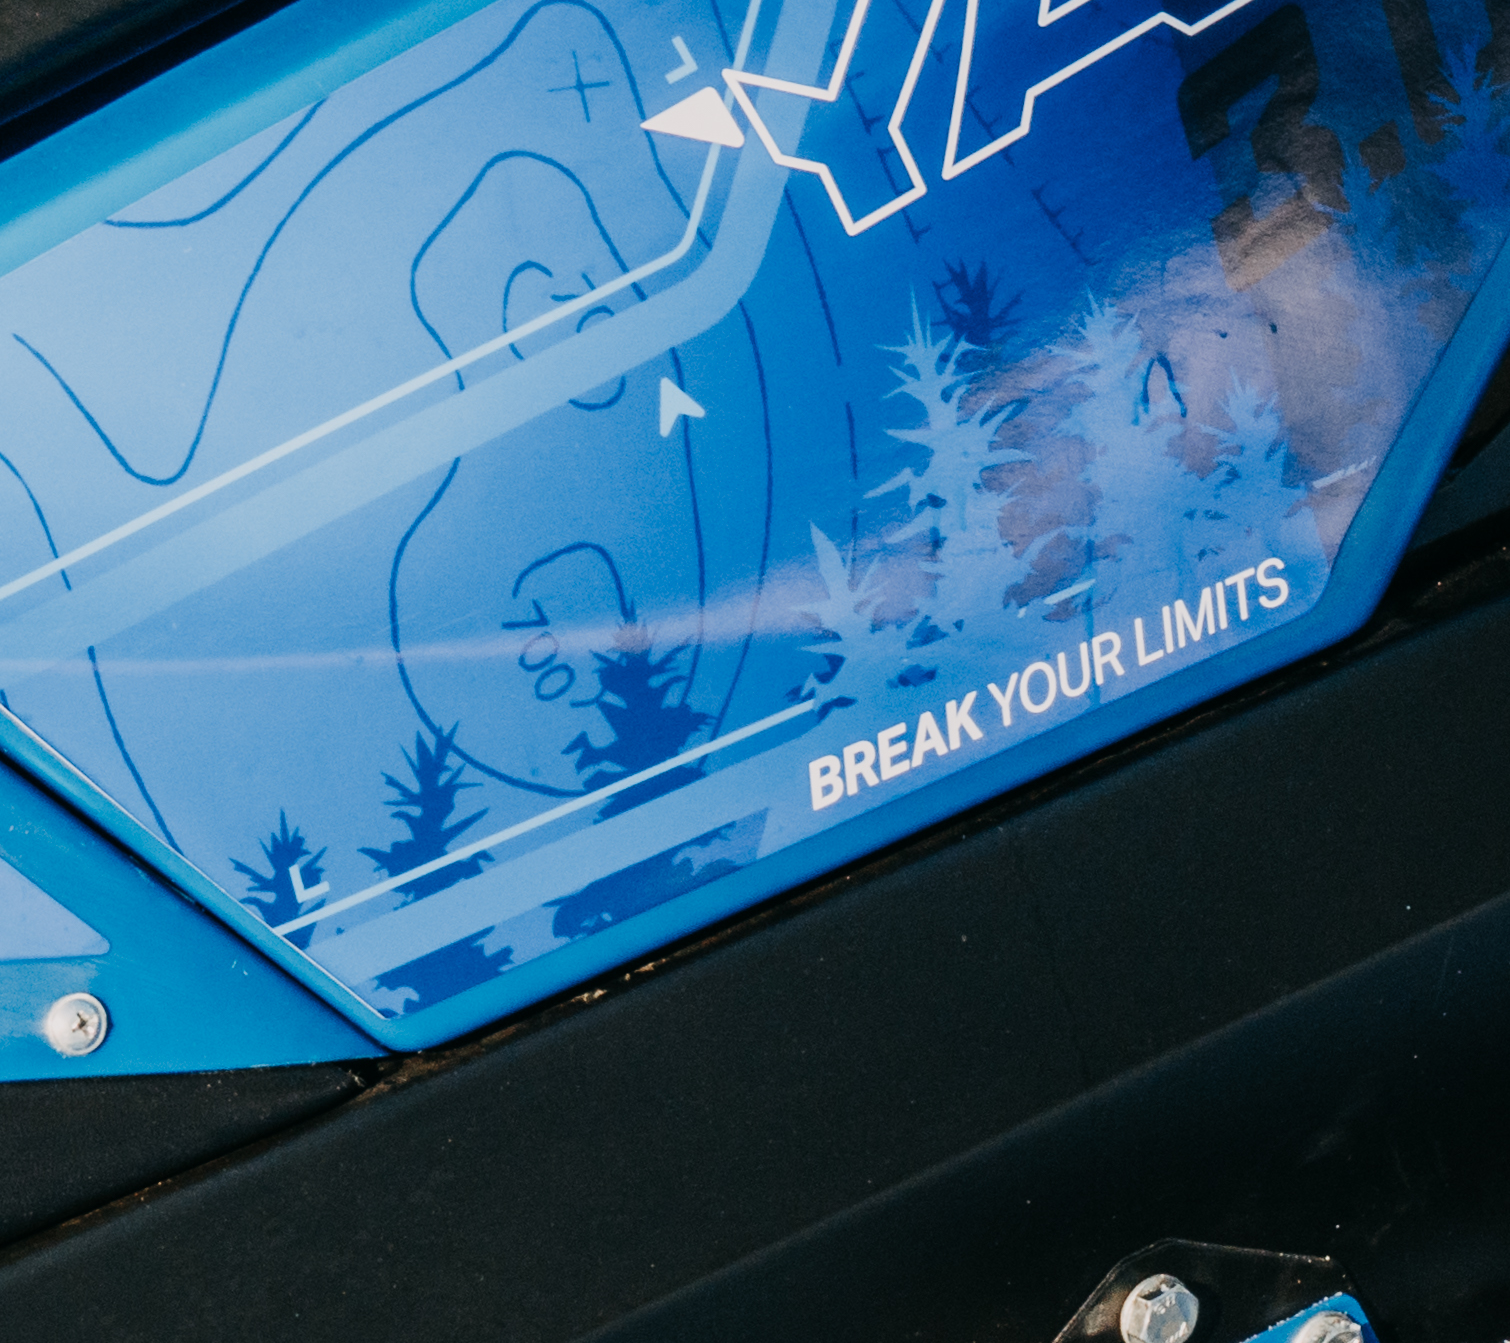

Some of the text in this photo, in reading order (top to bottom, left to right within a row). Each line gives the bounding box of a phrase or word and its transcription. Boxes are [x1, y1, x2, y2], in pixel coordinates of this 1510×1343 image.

[807, 556, 1291, 812] BREAK YOUR LIMITS
